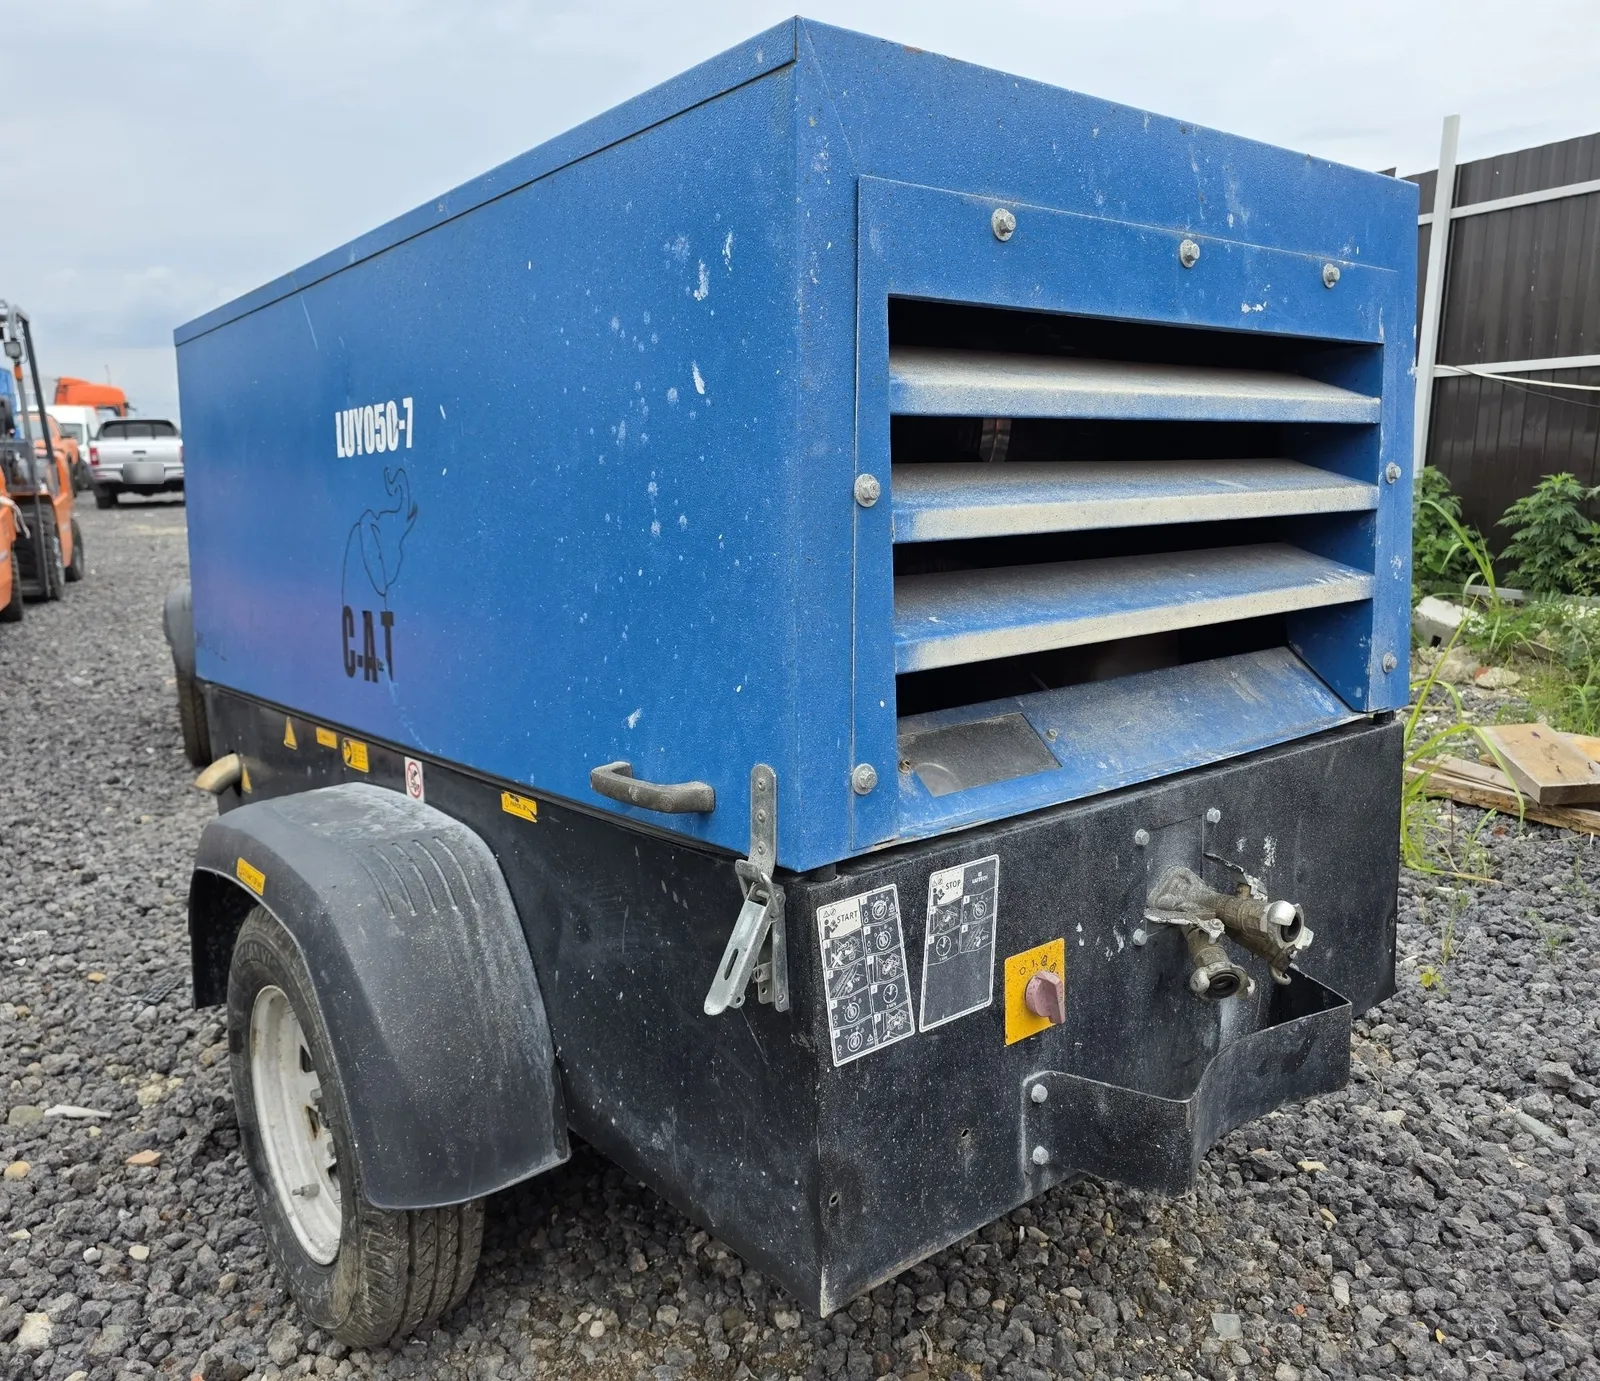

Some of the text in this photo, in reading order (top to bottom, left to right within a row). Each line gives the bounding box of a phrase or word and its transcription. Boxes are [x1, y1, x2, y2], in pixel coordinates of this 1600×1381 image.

[335, 396, 413, 459] LUY050-7
[945, 879, 961, 890] STOP
[836, 909, 858, 924] START
